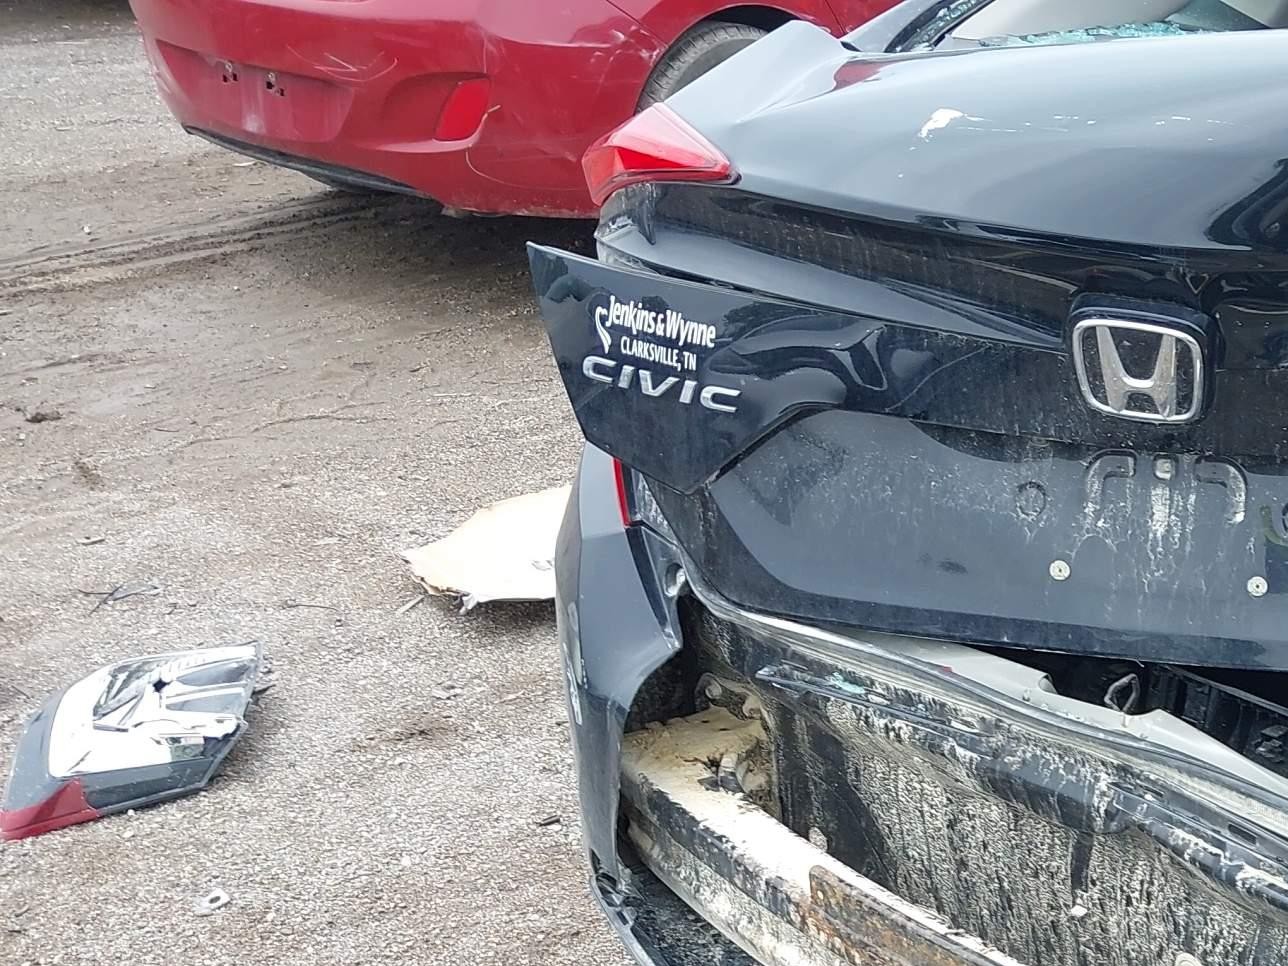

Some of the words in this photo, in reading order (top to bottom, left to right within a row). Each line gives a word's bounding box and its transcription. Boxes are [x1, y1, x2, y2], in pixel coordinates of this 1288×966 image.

[620, 335, 682, 372] CLARKSVILLE,
[682, 350, 697, 371] TN
[582, 354, 742, 413] CIVIC
